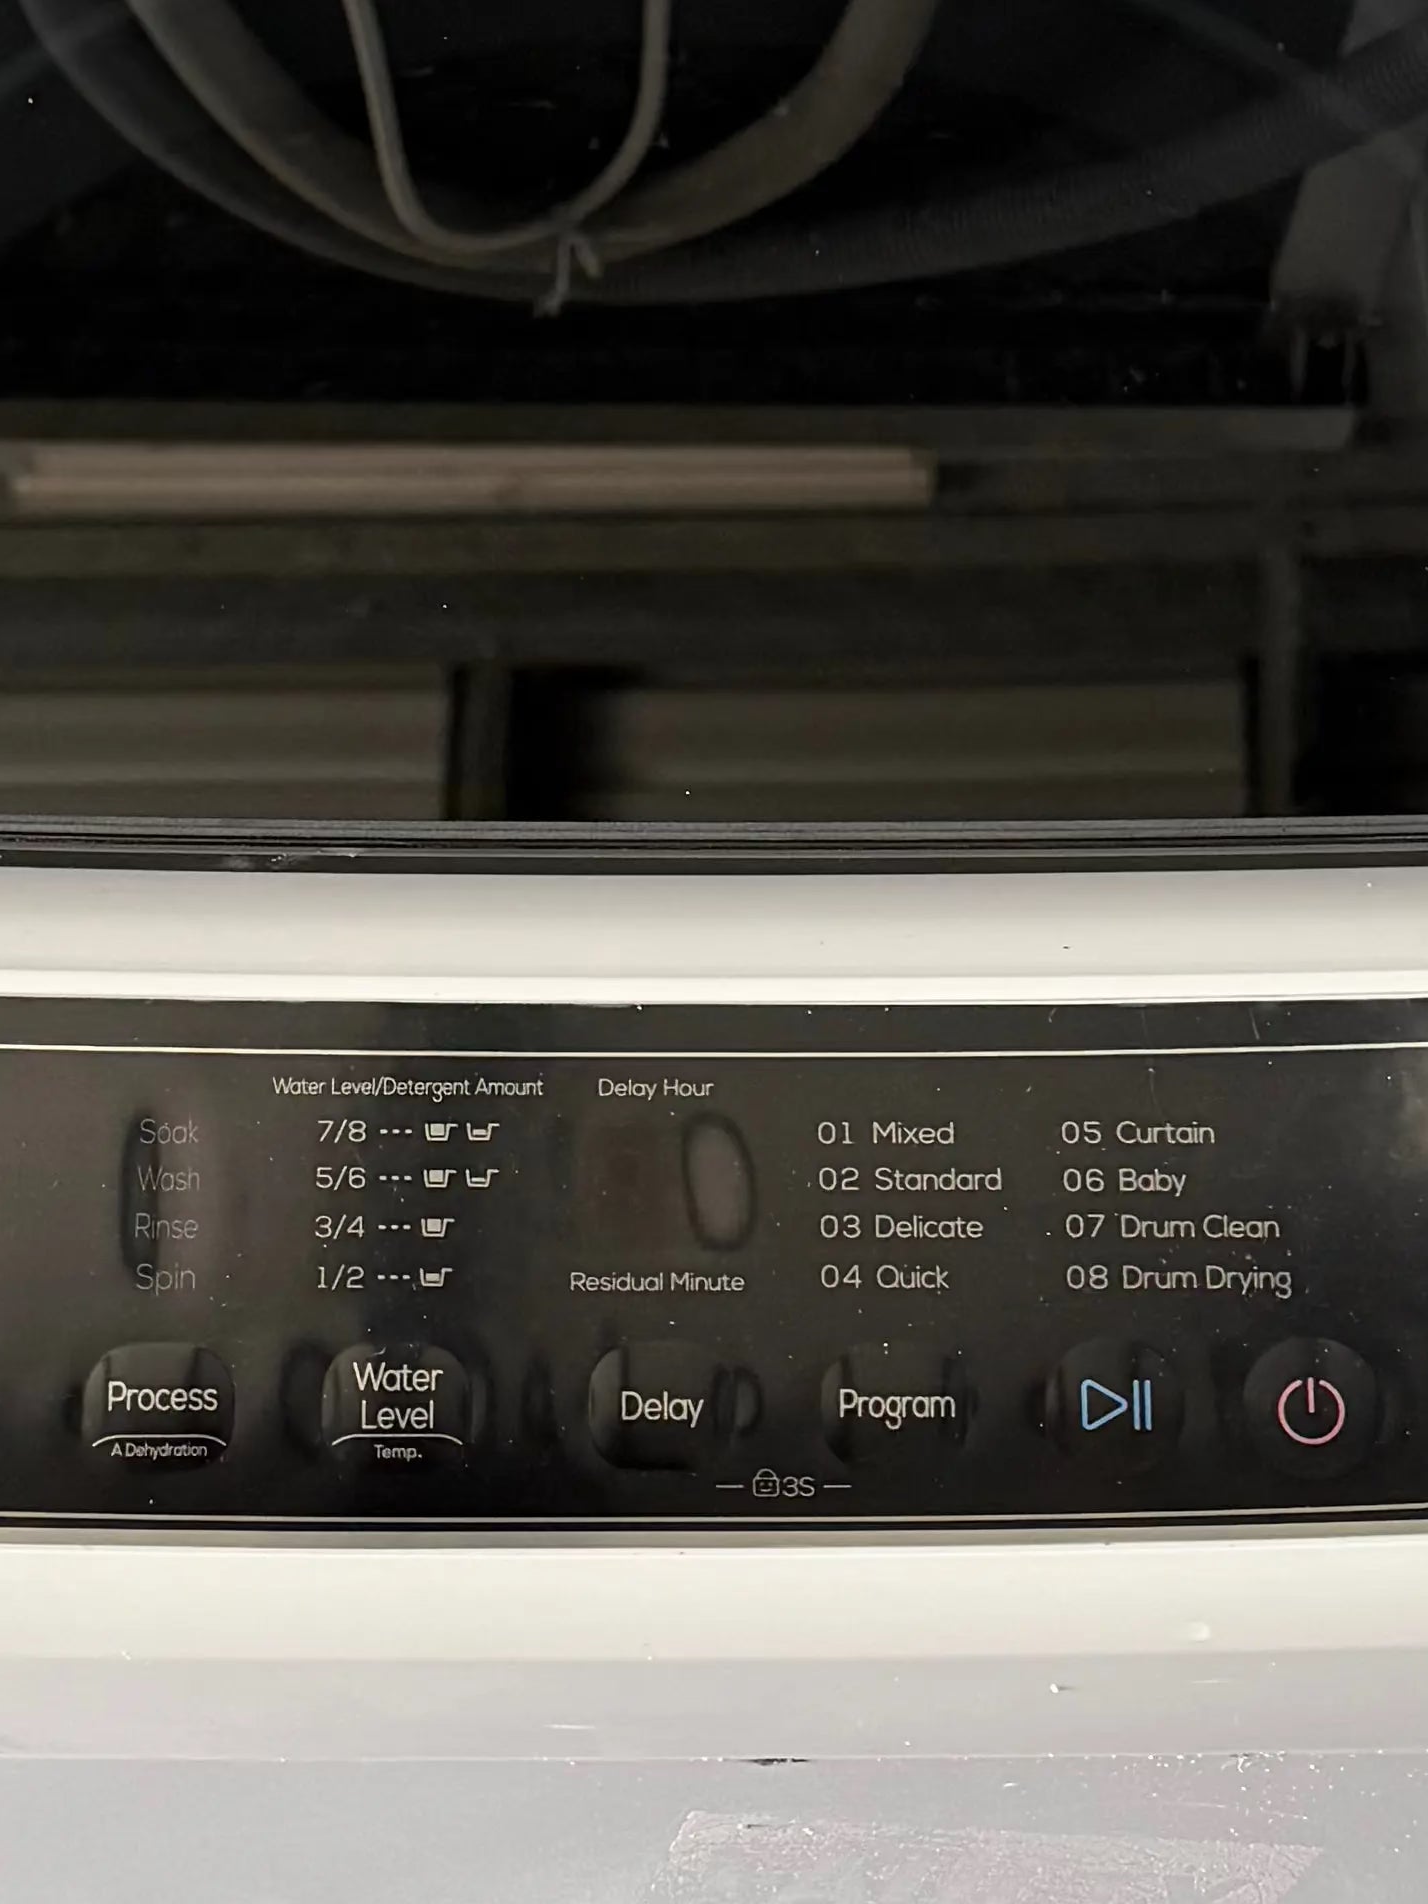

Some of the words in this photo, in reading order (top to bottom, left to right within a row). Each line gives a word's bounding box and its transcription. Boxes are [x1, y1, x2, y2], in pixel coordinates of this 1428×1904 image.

[273, 1077, 326, 1094] Water
[332, 1077, 470, 1102] Level/Detergent
[475, 1078, 543, 1095] Amount
[599, 1079, 657, 1100] Delay
[664, 1079, 714, 1096] Hour
[141, 1119, 199, 1144] Soak
[318, 1119, 366, 1143] 7/8
[818, 1122, 852, 1144] 01
[873, 1122, 954, 1144] Mixed
[1062, 1121, 1101, 1143] 05
[1117, 1121, 1214, 1143] Curtain
[139, 1167, 200, 1191] Wash
[316, 1166, 365, 1190] 5/6
[819, 1168, 859, 1190] 02
[875, 1168, 1001, 1190] Standard
[1064, 1169, 1104, 1192] 06
[1119, 1168, 1186, 1196] Baby
[136, 1213, 199, 1239] Rinse
[315, 1215, 364, 1239] 3/4
[821, 1215, 861, 1238] 03
[876, 1215, 983, 1238] Delicate
[1066, 1214, 1105, 1238] 07
[1121, 1215, 1195, 1238] Drum
[1203, 1215, 1279, 1238] Clean
[137, 1263, 195, 1296] Spin
[318, 1264, 364, 1290] 1/2
[569, 1272, 663, 1292] Residual
[669, 1272, 744, 1291] Minute
[821, 1265, 862, 1288] 04
[877, 1265, 949, 1288] Quick
[1067, 1265, 1108, 1289] 08
[1123, 1265, 1201, 1289] Drum
[1206, 1265, 1292, 1299] Drying
[353, 1362, 443, 1391] Water
[108, 1381, 217, 1411] Process
[362, 1400, 433, 1429] Level
[622, 1391, 704, 1427] Delay
[840, 1389, 955, 1429] Program
[127, 1441, 208, 1460] Dehydration
[374, 1444, 422, 1461] Temp.
[782, 1477, 814, 1497] 3S
